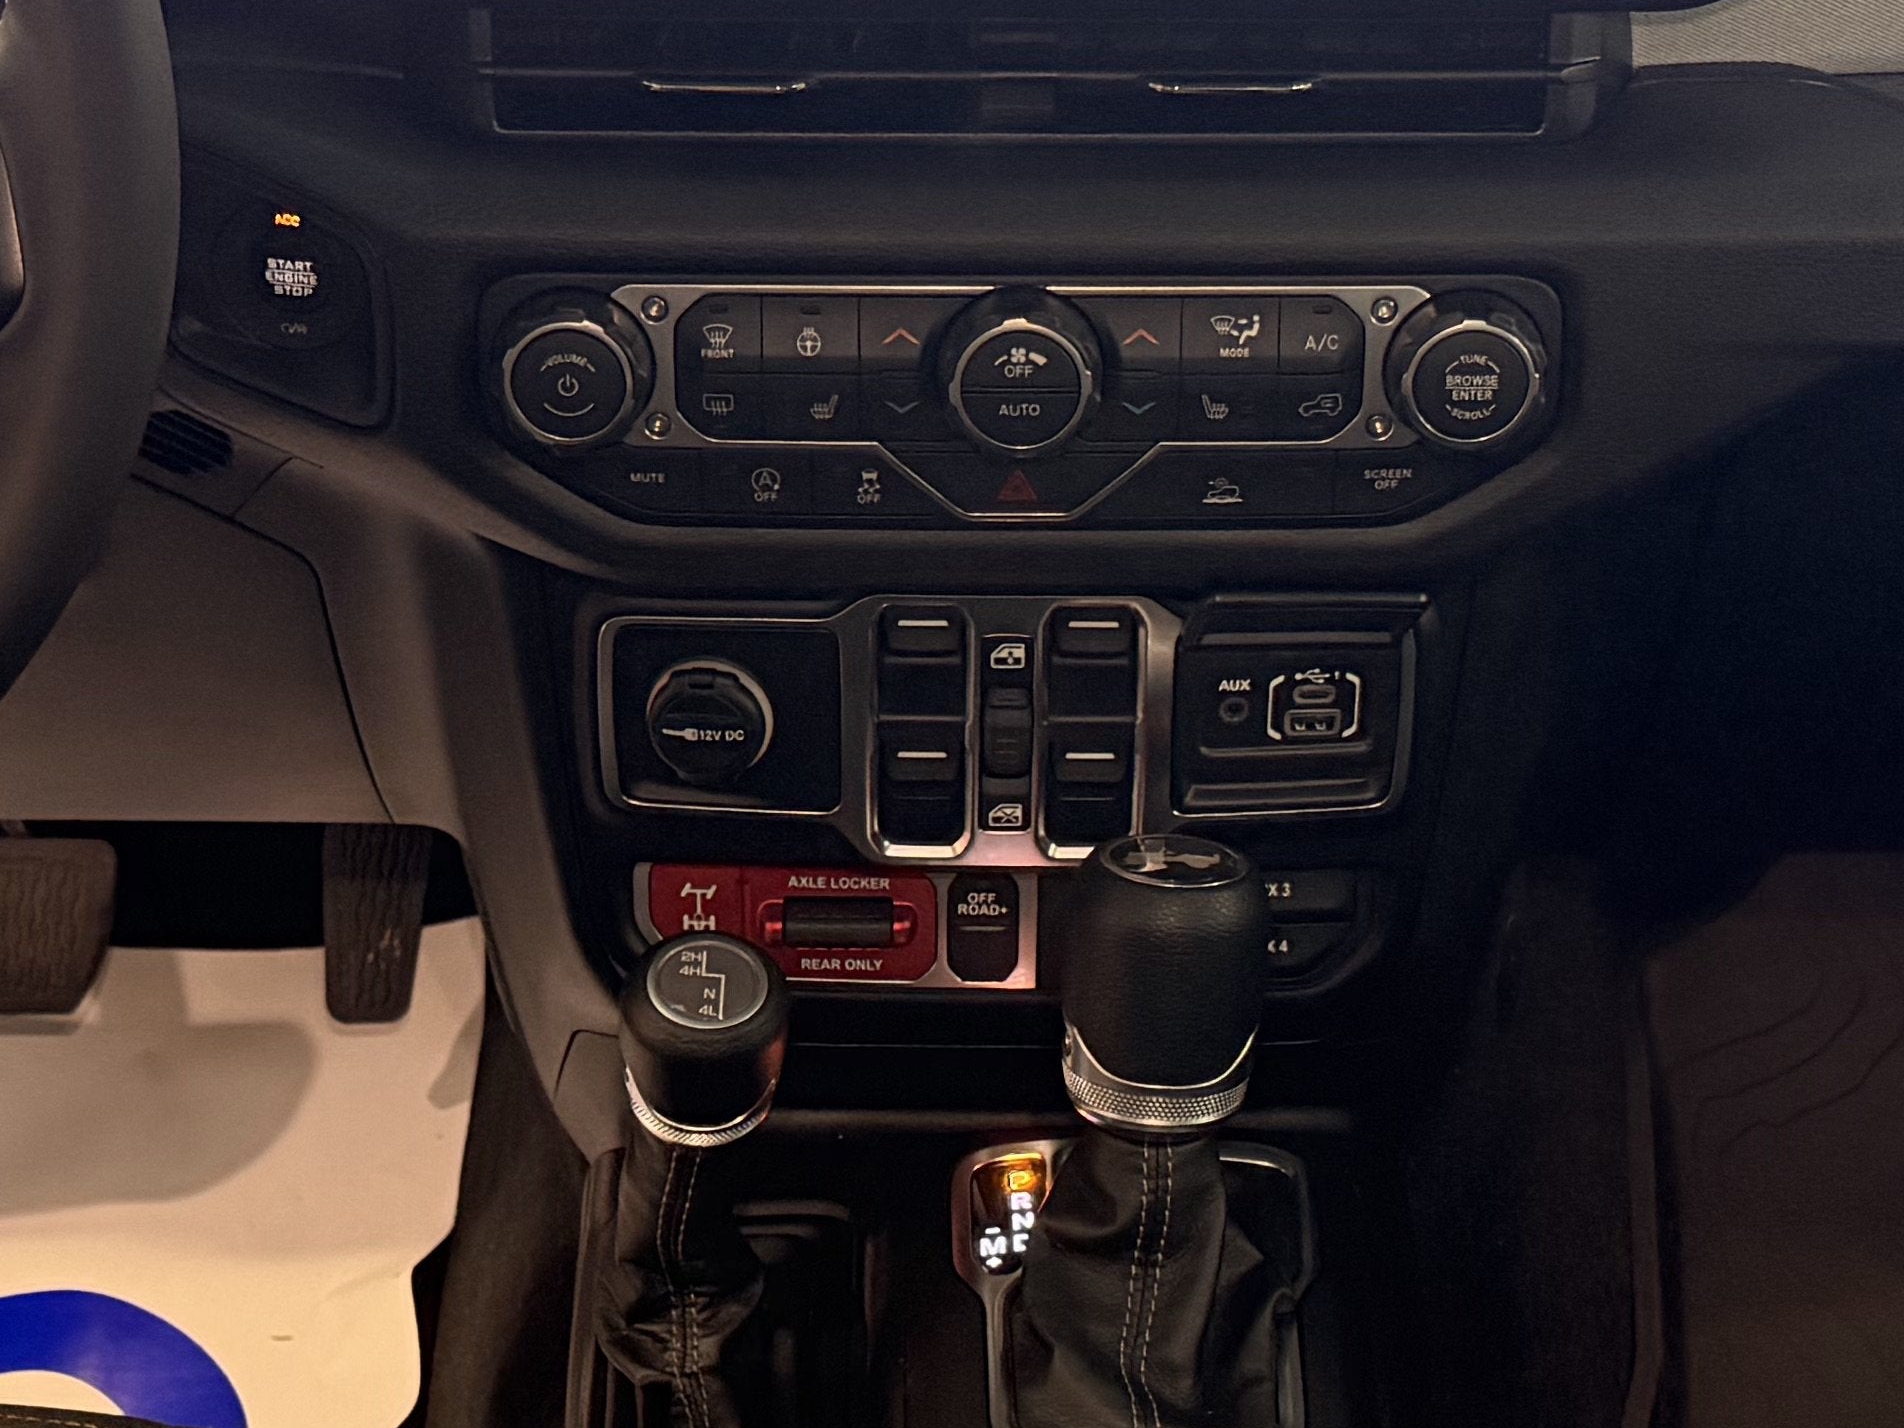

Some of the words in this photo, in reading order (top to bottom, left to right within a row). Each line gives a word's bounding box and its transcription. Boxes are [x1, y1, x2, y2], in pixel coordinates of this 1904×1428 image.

[267, 257, 314, 272] START
[264, 269, 318, 286] ENGINE
[274, 285, 314, 297] STOP
[1304, 333, 1340, 352] A/C
[700, 348, 735, 359] FRONT
[1219, 347, 1250, 358] MODE
[1004, 365, 1033, 378] OFF
[1445, 374, 1499, 388] BROWSE
[1451, 389, 1493, 402] ENTER
[999, 403, 1040, 417] AUTO
[630, 472, 666, 483] MUTE
[1363, 469, 1412, 479] SCREEN
[753, 491, 778, 503] OFF
[856, 491, 881, 504] OFF
[1219, 678, 1251, 692] AUX
[698, 729, 723, 741] 12V
[726, 729, 745, 741] DC
[787, 876, 826, 889] AXLE
[830, 876, 890, 890] LOCKER
[967, 892, 996, 904] OFF
[680, 951, 702, 962] 2H
[679, 965, 700, 976] 4H
[800, 957, 839, 971] REAR
[843, 957, 884, 971] ONLY
[703, 987, 716, 999] N
[698, 1004, 717, 1016] 4L
[1010, 1192, 1033, 1211] R
[1011, 1211, 1035, 1231] N
[979, 1236, 1007, 1258] M
